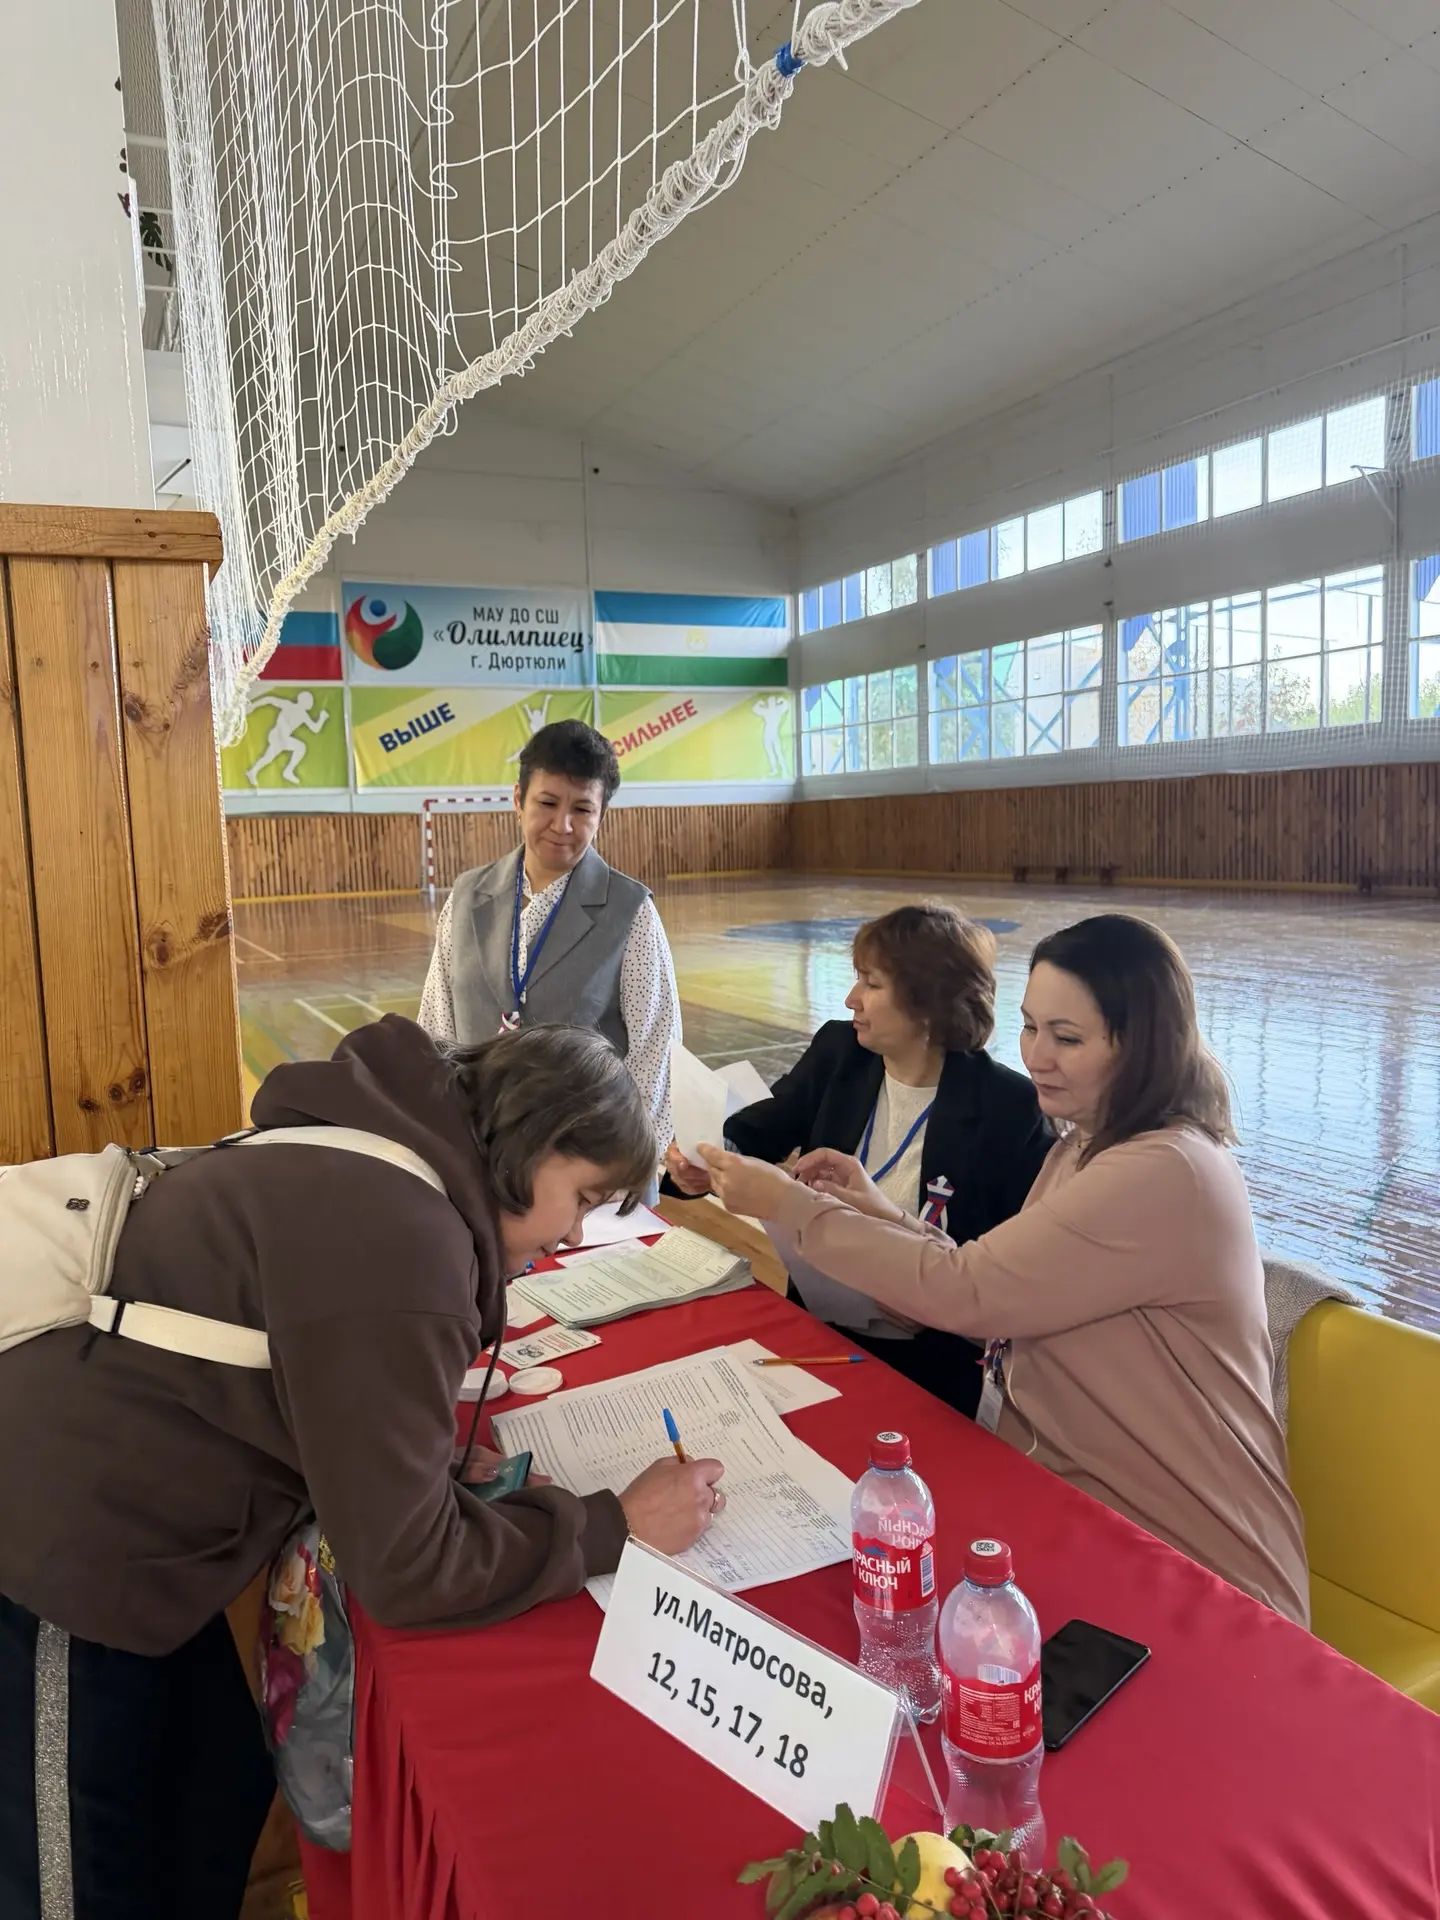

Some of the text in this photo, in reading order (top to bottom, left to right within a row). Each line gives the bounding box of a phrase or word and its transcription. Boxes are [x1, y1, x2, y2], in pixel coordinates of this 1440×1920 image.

[473, 606, 559, 625] МАУ ДО СШ
[470, 652, 566, 672] г. Дюртюли
[378, 702, 455, 754] ВЫШЕ
[612, 698, 698, 758] СИЛЬНЕЕ
[858, 1566, 899, 1591] КЛЮЧ
[653, 1586, 833, 1719] ул.Матросова,
[647, 1652, 809, 1778] 12, 15, 17, 18
